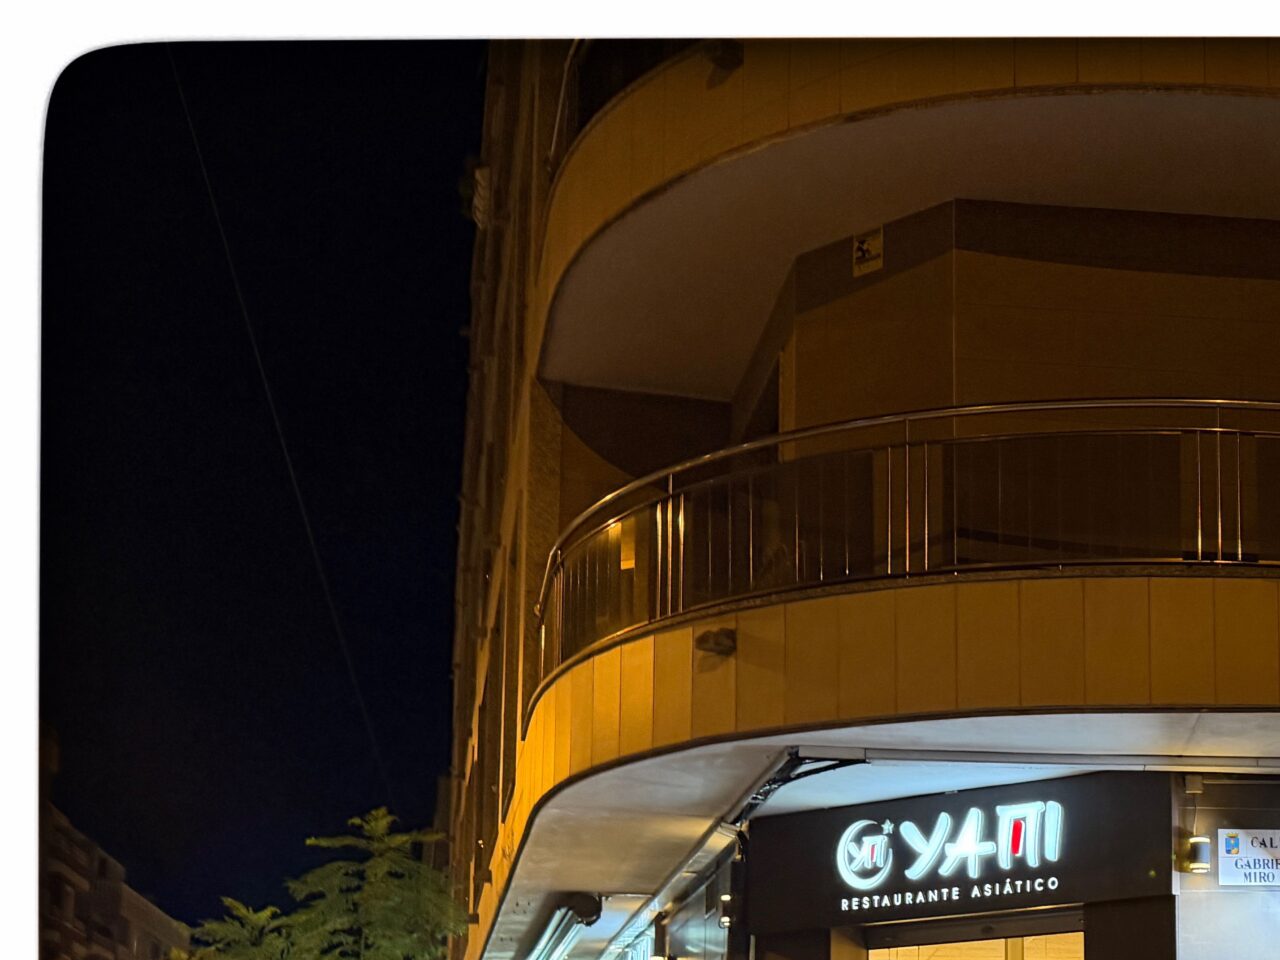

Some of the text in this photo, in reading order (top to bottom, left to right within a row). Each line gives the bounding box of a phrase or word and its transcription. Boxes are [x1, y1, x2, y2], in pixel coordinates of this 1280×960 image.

[1243, 871, 1276, 883] MIRO
[841, 877, 1060, 911] RESTAURANTE ASIÁTICO
